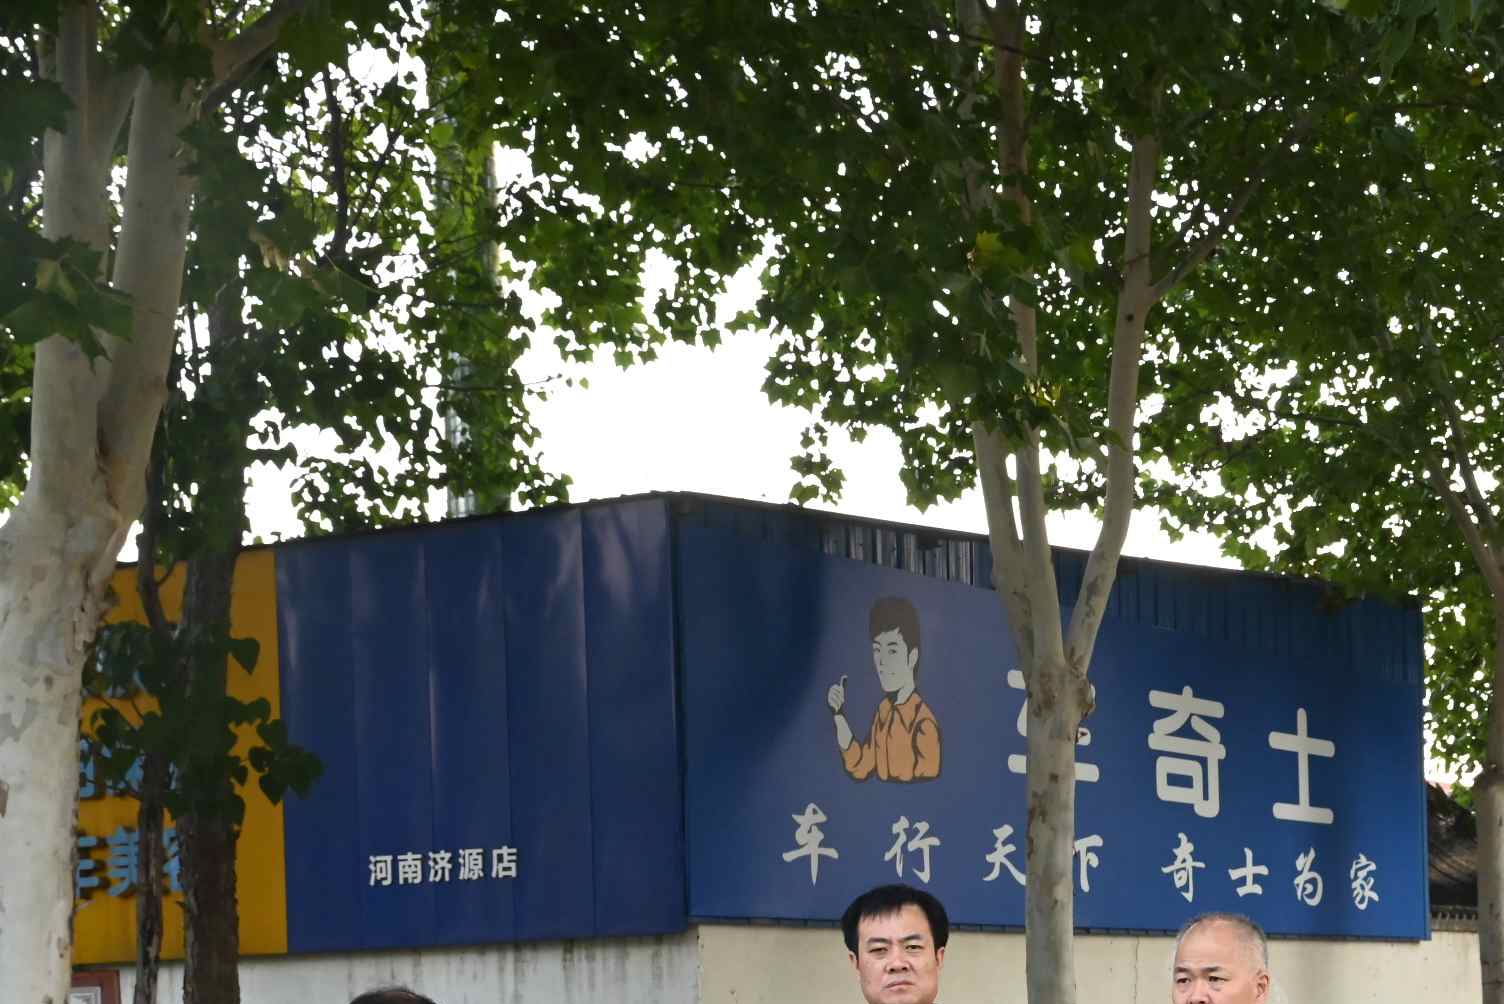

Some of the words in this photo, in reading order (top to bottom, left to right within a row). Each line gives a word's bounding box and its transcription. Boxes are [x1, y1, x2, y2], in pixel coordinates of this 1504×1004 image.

[368, 845, 518, 887] 河南济源店
